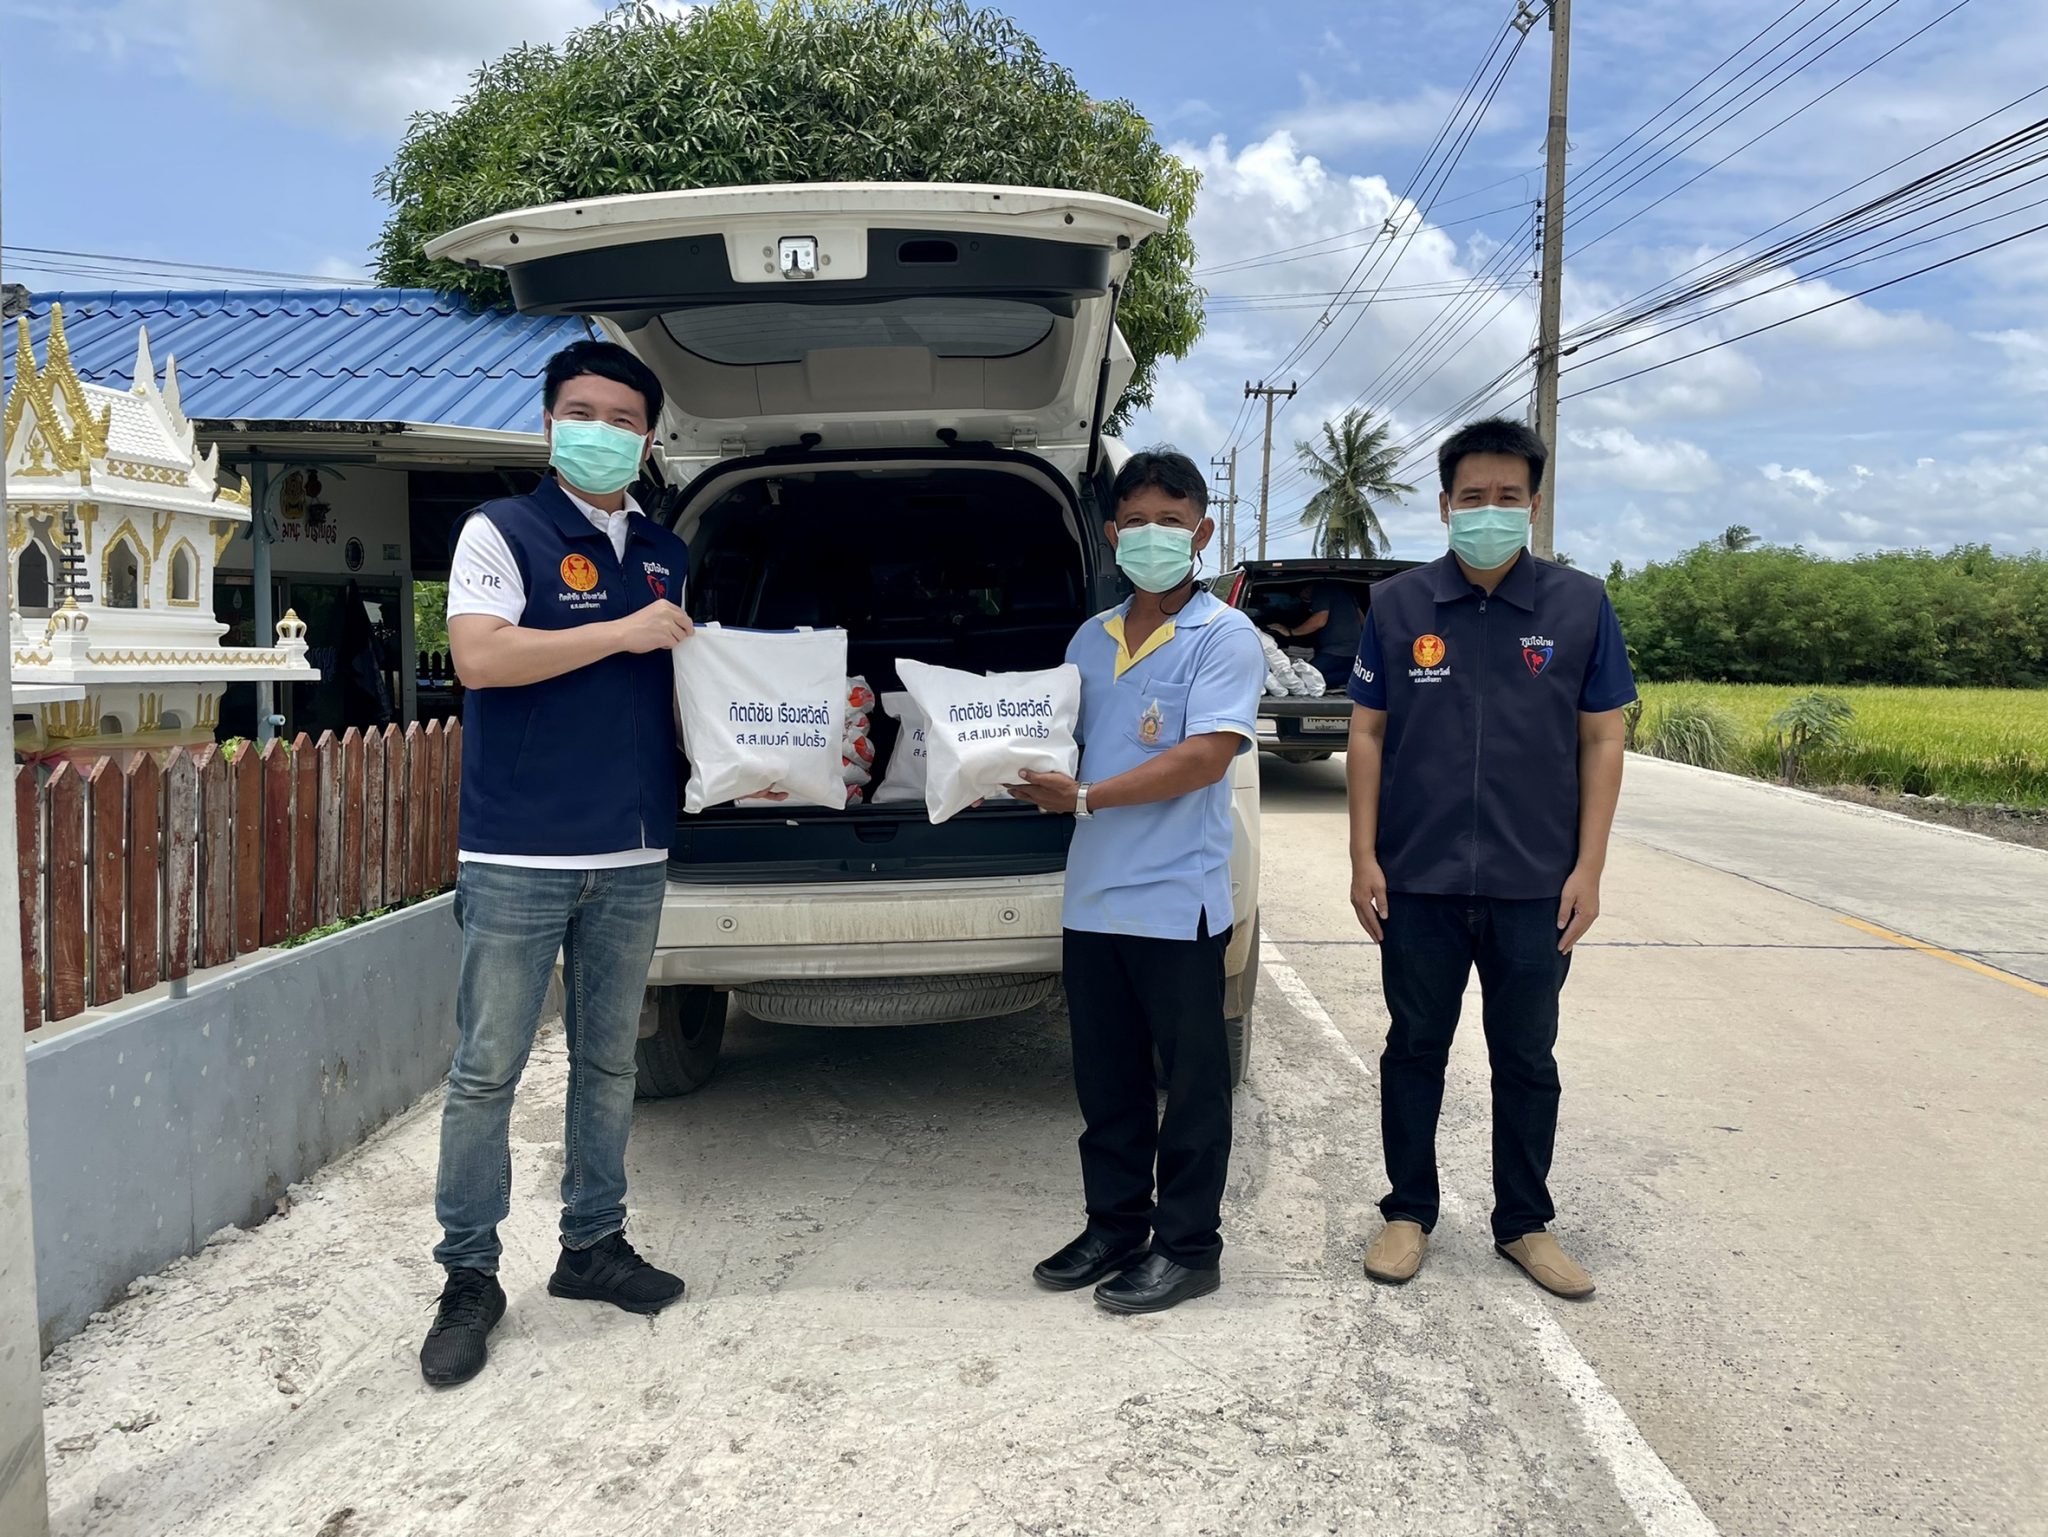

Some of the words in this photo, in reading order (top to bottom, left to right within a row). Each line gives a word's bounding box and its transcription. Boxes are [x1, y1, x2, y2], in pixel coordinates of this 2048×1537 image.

[729, 701, 773, 722] กิตติชัย
[777, 700, 830, 725] เรืองสวัสดิ์
[948, 701, 993, 723] กิตติชัย
[996, 694, 1053, 718] เรืองสวัสดิ์
[736, 731, 790, 746] ส.ส.แบงค์
[792, 729, 827, 748] แปดริ้ว
[957, 724, 1011, 742] ส.ส.แบงค์
[1014, 720, 1050, 739] แปดริ้ว
